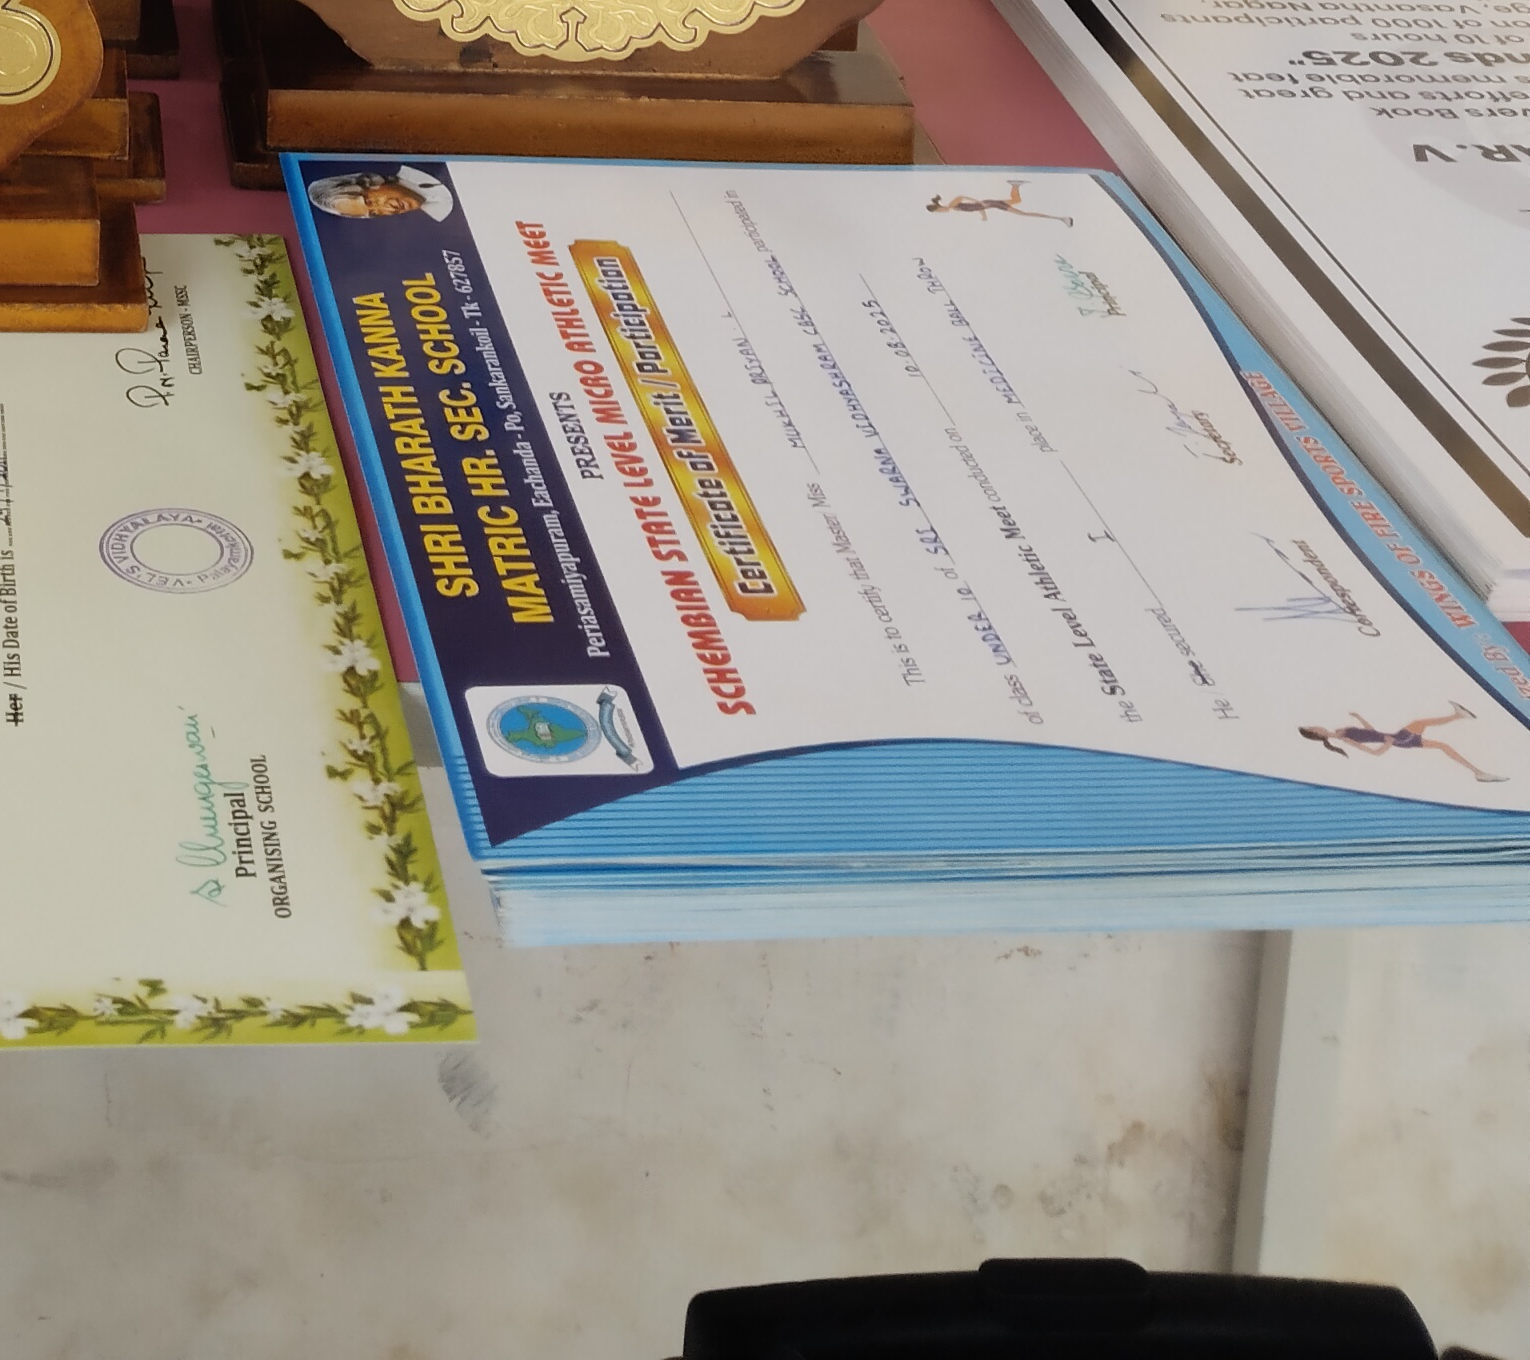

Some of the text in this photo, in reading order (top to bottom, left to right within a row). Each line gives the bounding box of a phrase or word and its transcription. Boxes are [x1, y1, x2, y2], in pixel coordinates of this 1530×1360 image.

[1228, 72, 1505, 85] memorable feat
[1239, 86, 1409, 101] and great
[1370, 107, 1457, 120] Book
[442, 248, 473, 294] 627857
[462, 300, 483, 319] Tk
[470, 326, 517, 410] Sankarankoil
[353, 290, 477, 597] SHRI BHARATH KANNA
[403, 271, 552, 623] MATRIC HR. SEC. SCHOOL
[503, 410, 525, 432] Po,
[547, 390, 605, 480] PRESENTS
[593, 255, 775, 598] Certificate of Merit / Participation
[513, 440, 554, 508] Eachanda
[514, 219, 754, 716] SCHEMBIAN STATE LEVEL MICRO ATHLETIC MEET
[1243, 370, 1476, 628] WINGS OF FIRE SPORTS VILLAGE
[223, 792, 257, 879] Principal
[248, 753, 292, 919] ORGANISING SCHOOL
